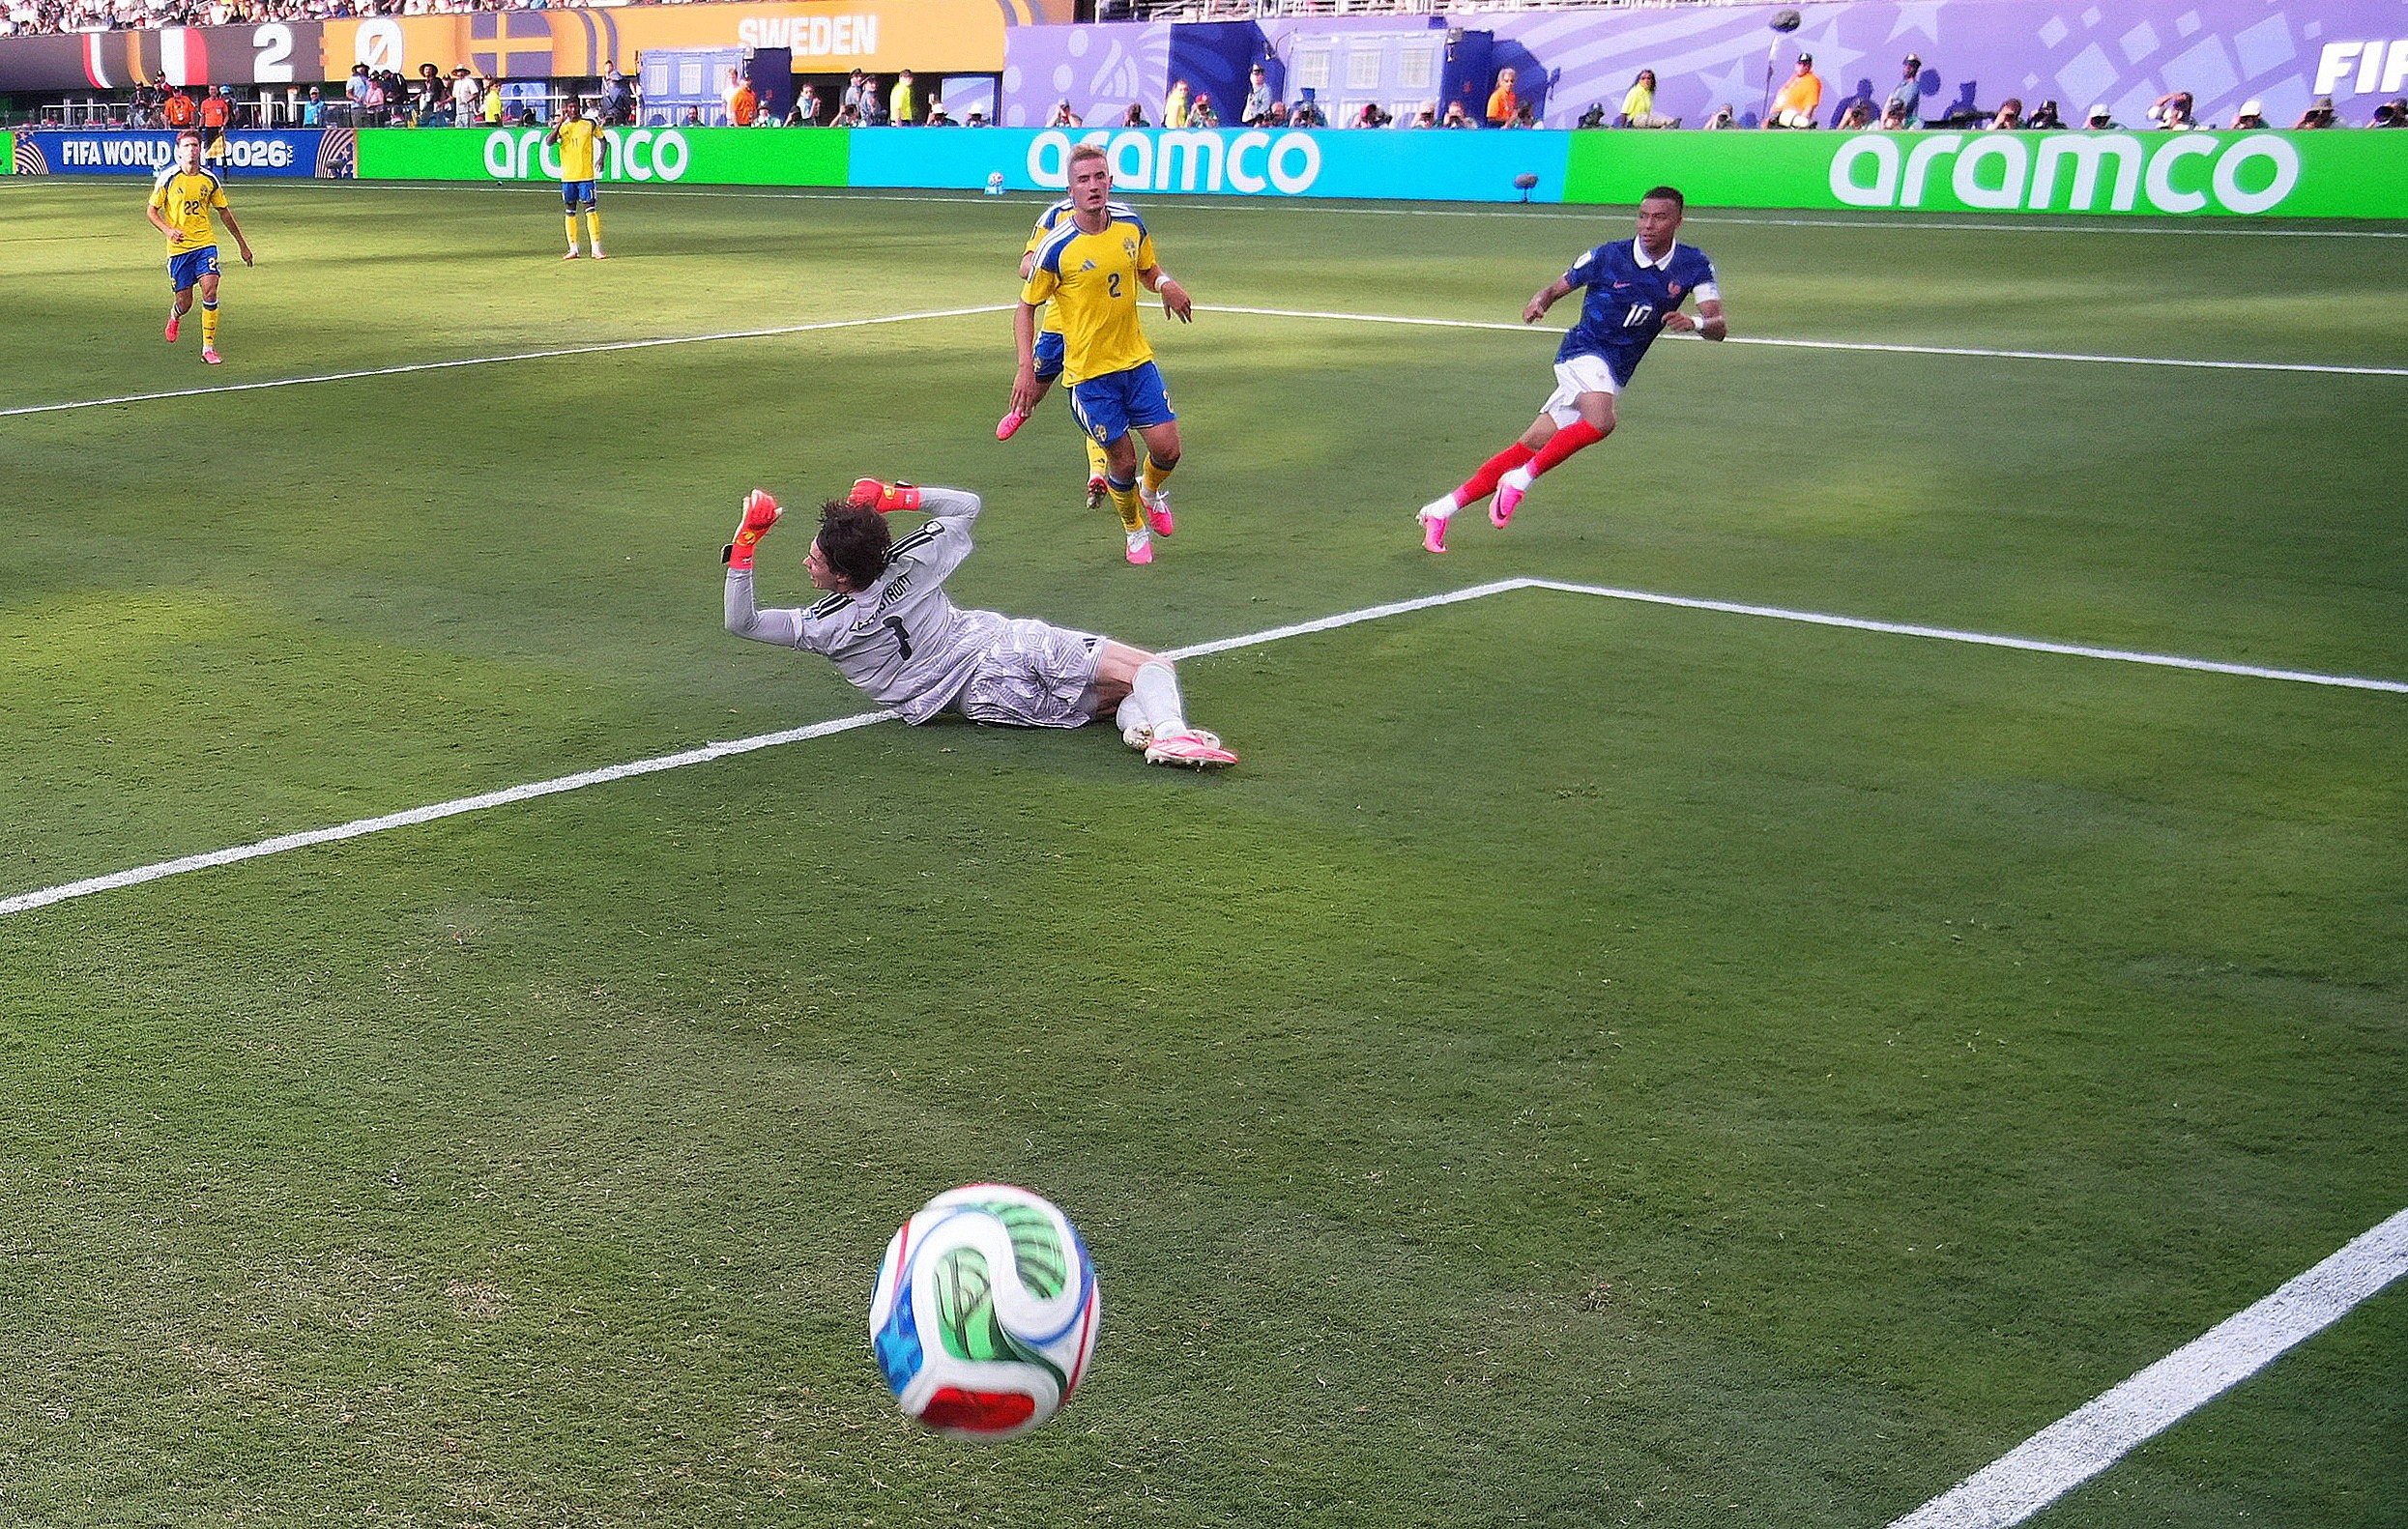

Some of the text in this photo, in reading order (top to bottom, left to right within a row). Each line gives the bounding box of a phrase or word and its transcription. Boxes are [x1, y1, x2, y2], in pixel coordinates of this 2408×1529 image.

[738, 14, 877, 56] SWEDEN
[253, 23, 294, 82] 2
[62, 140, 101, 165] FIFA
[103, 140, 170, 166] WORLD
[1829, 133, 2299, 215] aramco
[184, 200, 200, 216] 22
[1107, 273, 1121, 298] 2
[1622, 303, 1653, 328] 10
